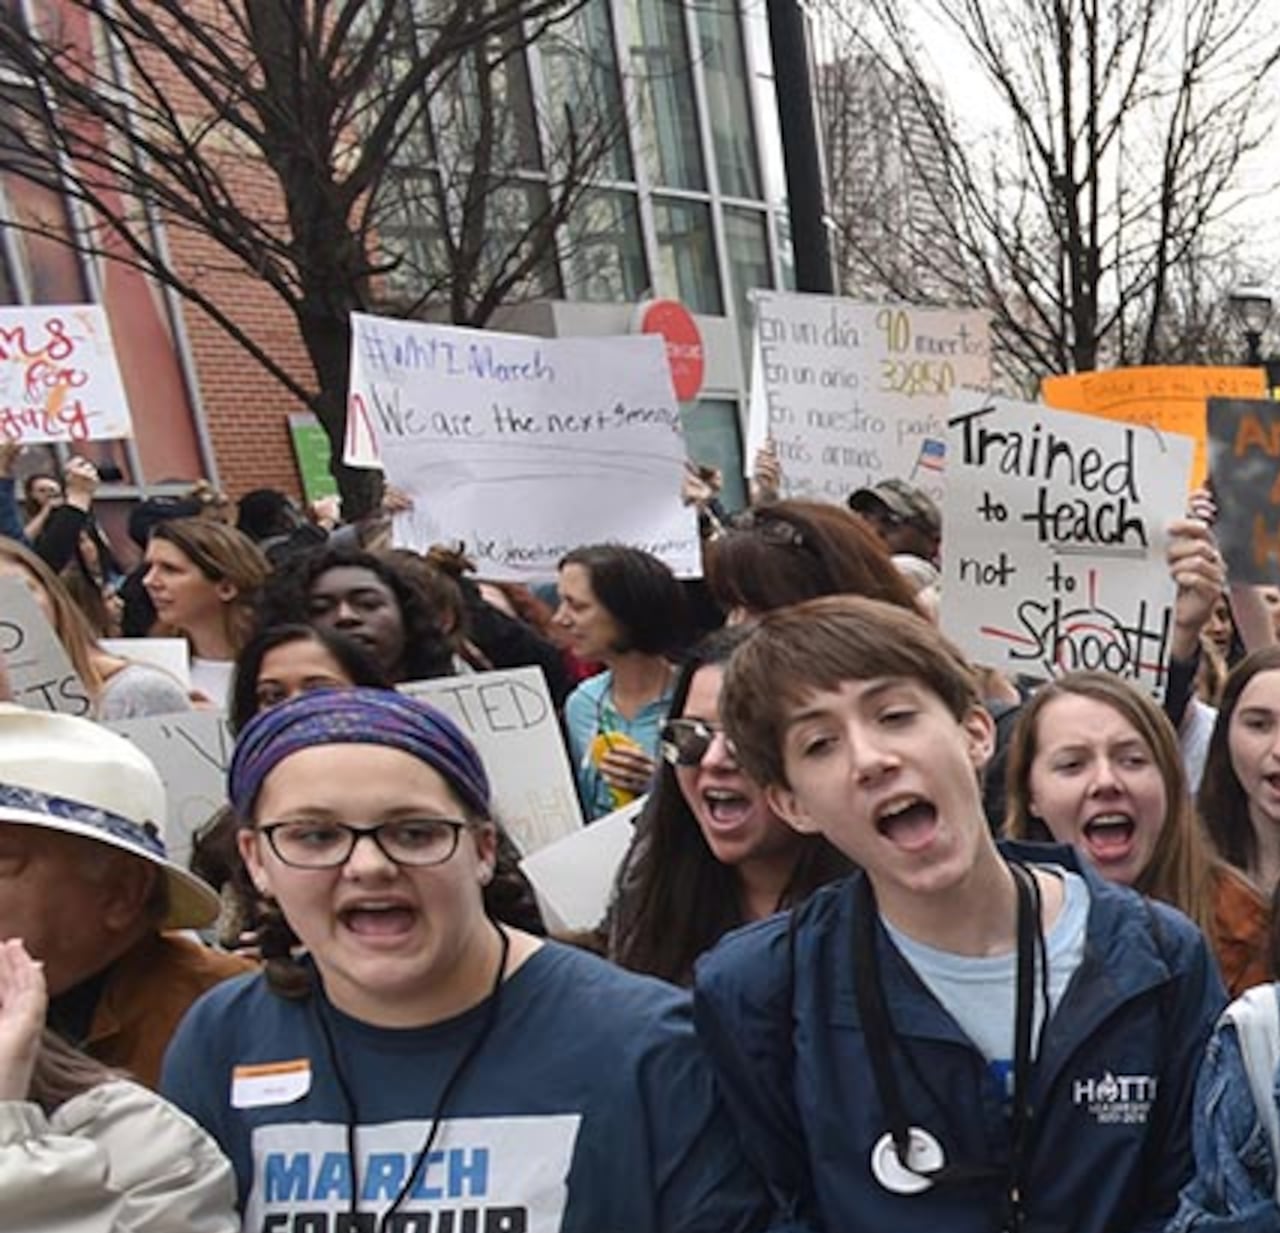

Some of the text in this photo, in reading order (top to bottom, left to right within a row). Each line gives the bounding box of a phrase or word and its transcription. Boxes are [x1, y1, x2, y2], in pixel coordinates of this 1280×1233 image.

[948, 406, 1140, 504] Trained
[977, 486, 1149, 547] to teach
[959, 551, 1077, 592] not to
[264, 1147, 490, 1202] MARCH
